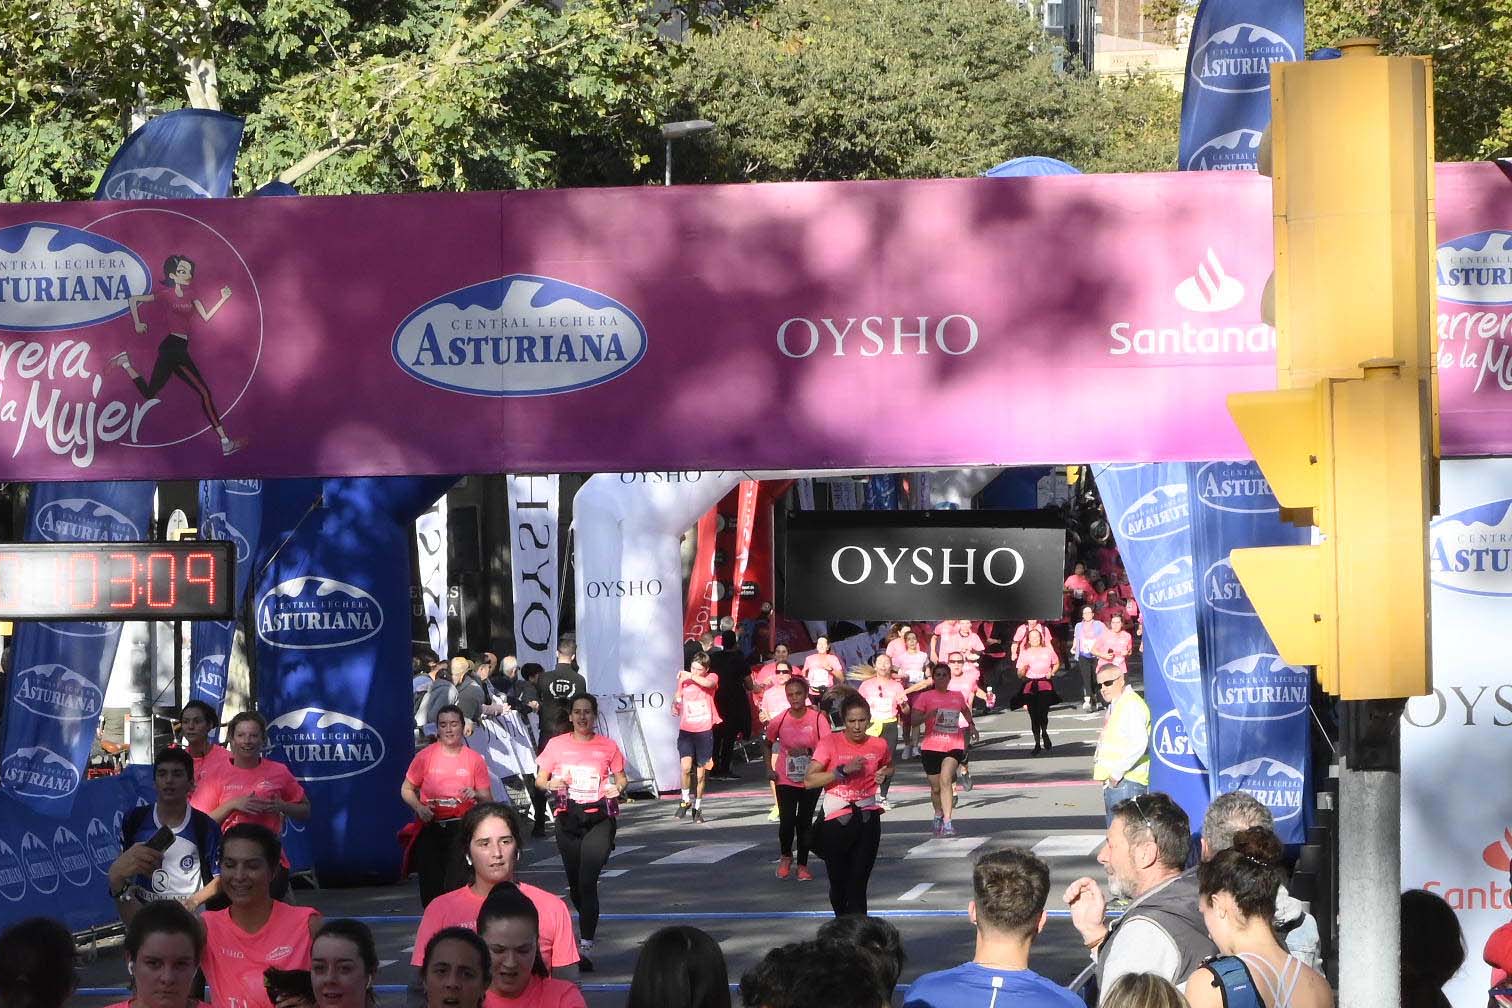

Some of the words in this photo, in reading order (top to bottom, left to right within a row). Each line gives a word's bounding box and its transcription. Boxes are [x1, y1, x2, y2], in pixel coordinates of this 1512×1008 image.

[54, 258, 126, 271] LECHERA
[451, 318, 534, 331] CENTRAL
[538, 315, 618, 328] LECHERA
[777, 314, 979, 358] OYSHO
[1109, 322, 1277, 355] Santand
[411, 322, 629, 366] ASTURIANA
[1460, 341, 1478, 369] la
[12, 376, 161, 468] Mujer
[1202, 472, 1274, 498] ASTUR
[831, 545, 1025, 587] OYSHO
[587, 579, 663, 598] OYSHO
[261, 605, 376, 634] ASTURIANA
[16, 677, 96, 714] ASTURIANA
[617, 692, 665, 710] SHO
[1403, 685, 1512, 728] OYS
